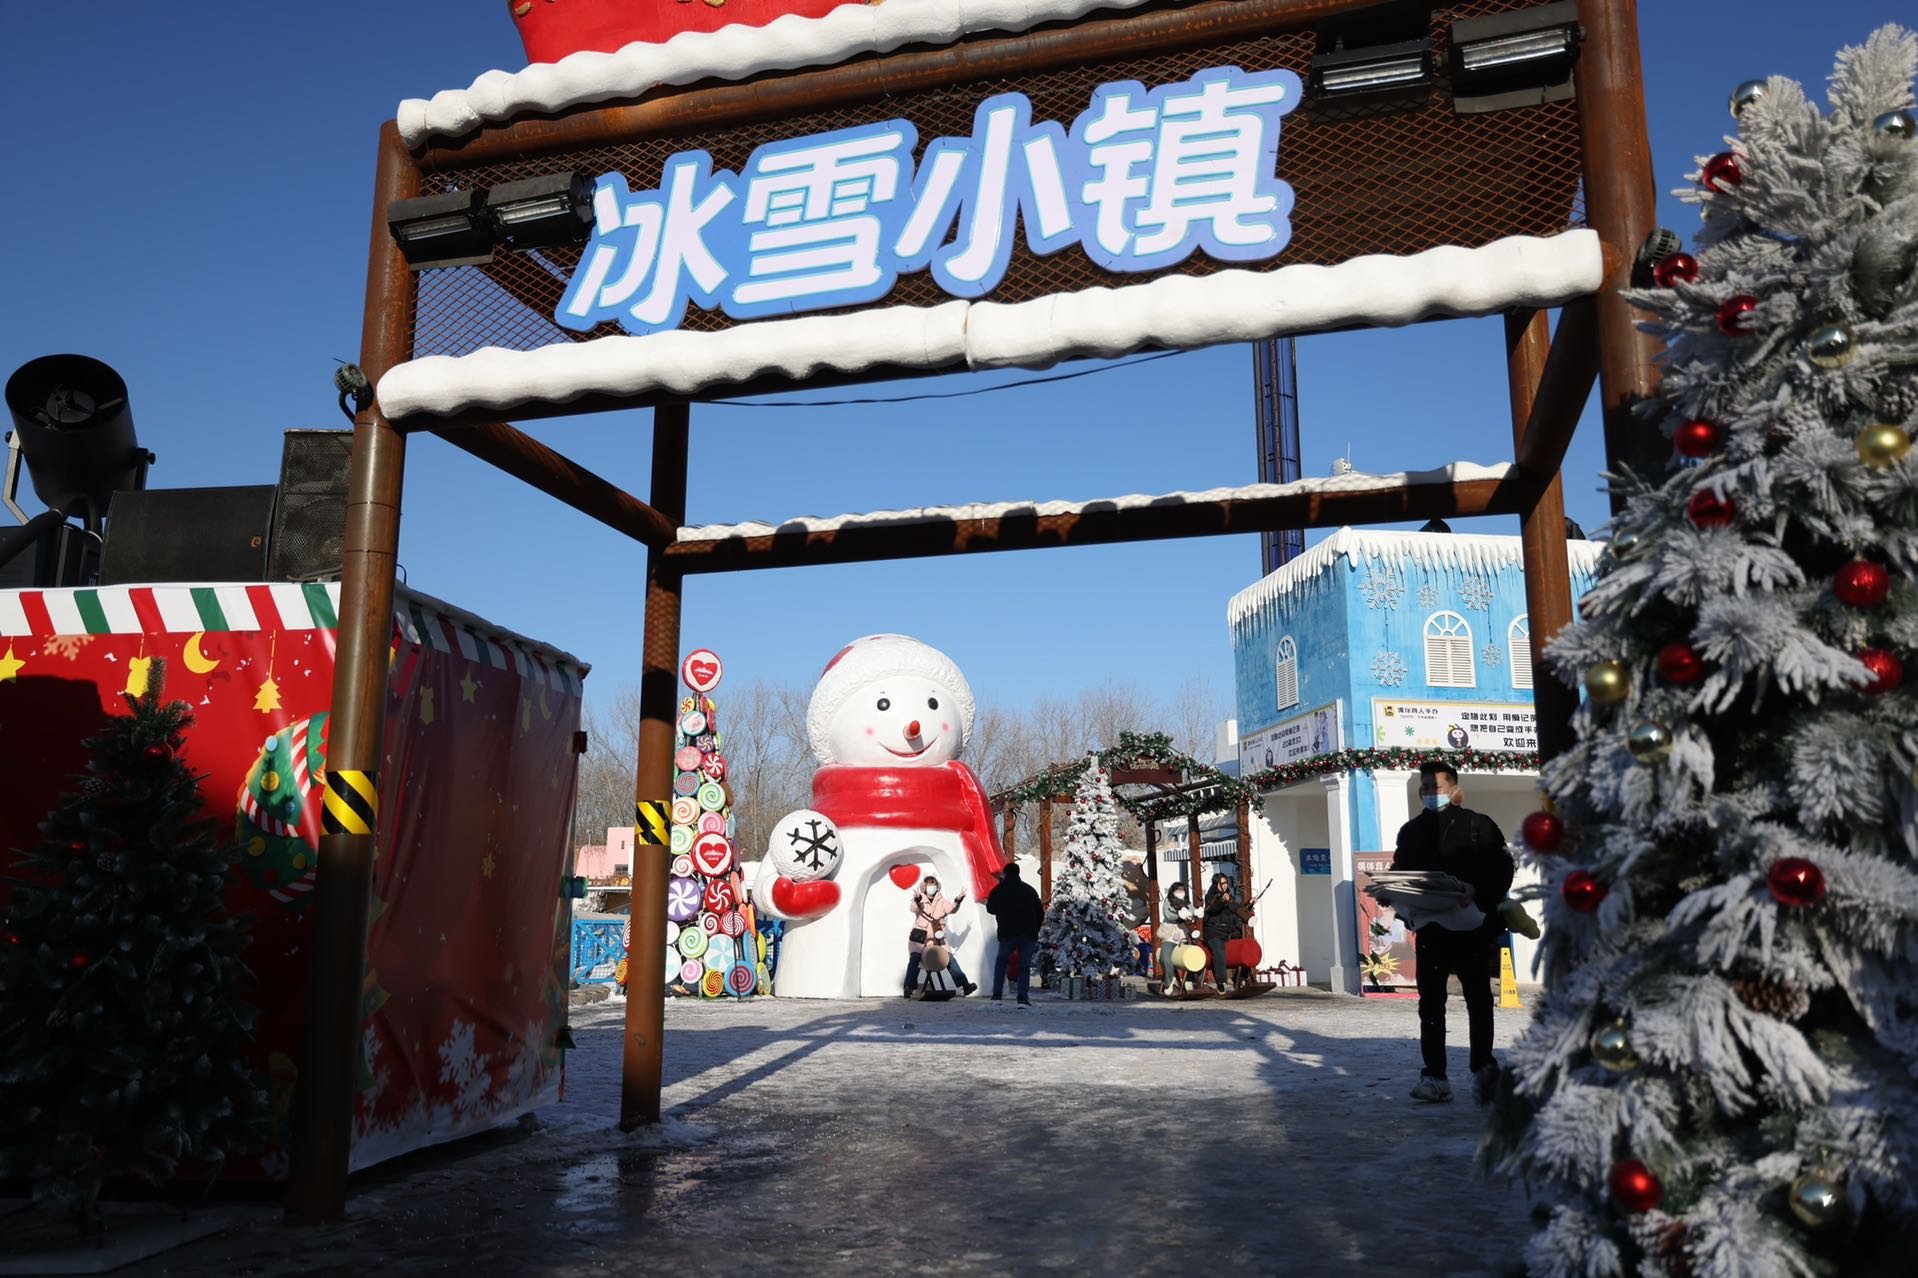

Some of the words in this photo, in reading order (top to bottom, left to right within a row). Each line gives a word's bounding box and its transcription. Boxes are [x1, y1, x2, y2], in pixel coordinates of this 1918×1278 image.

[567, 78, 1287, 327] 冰雪小镇
[1461, 712, 1498, 721] 定格此刻
